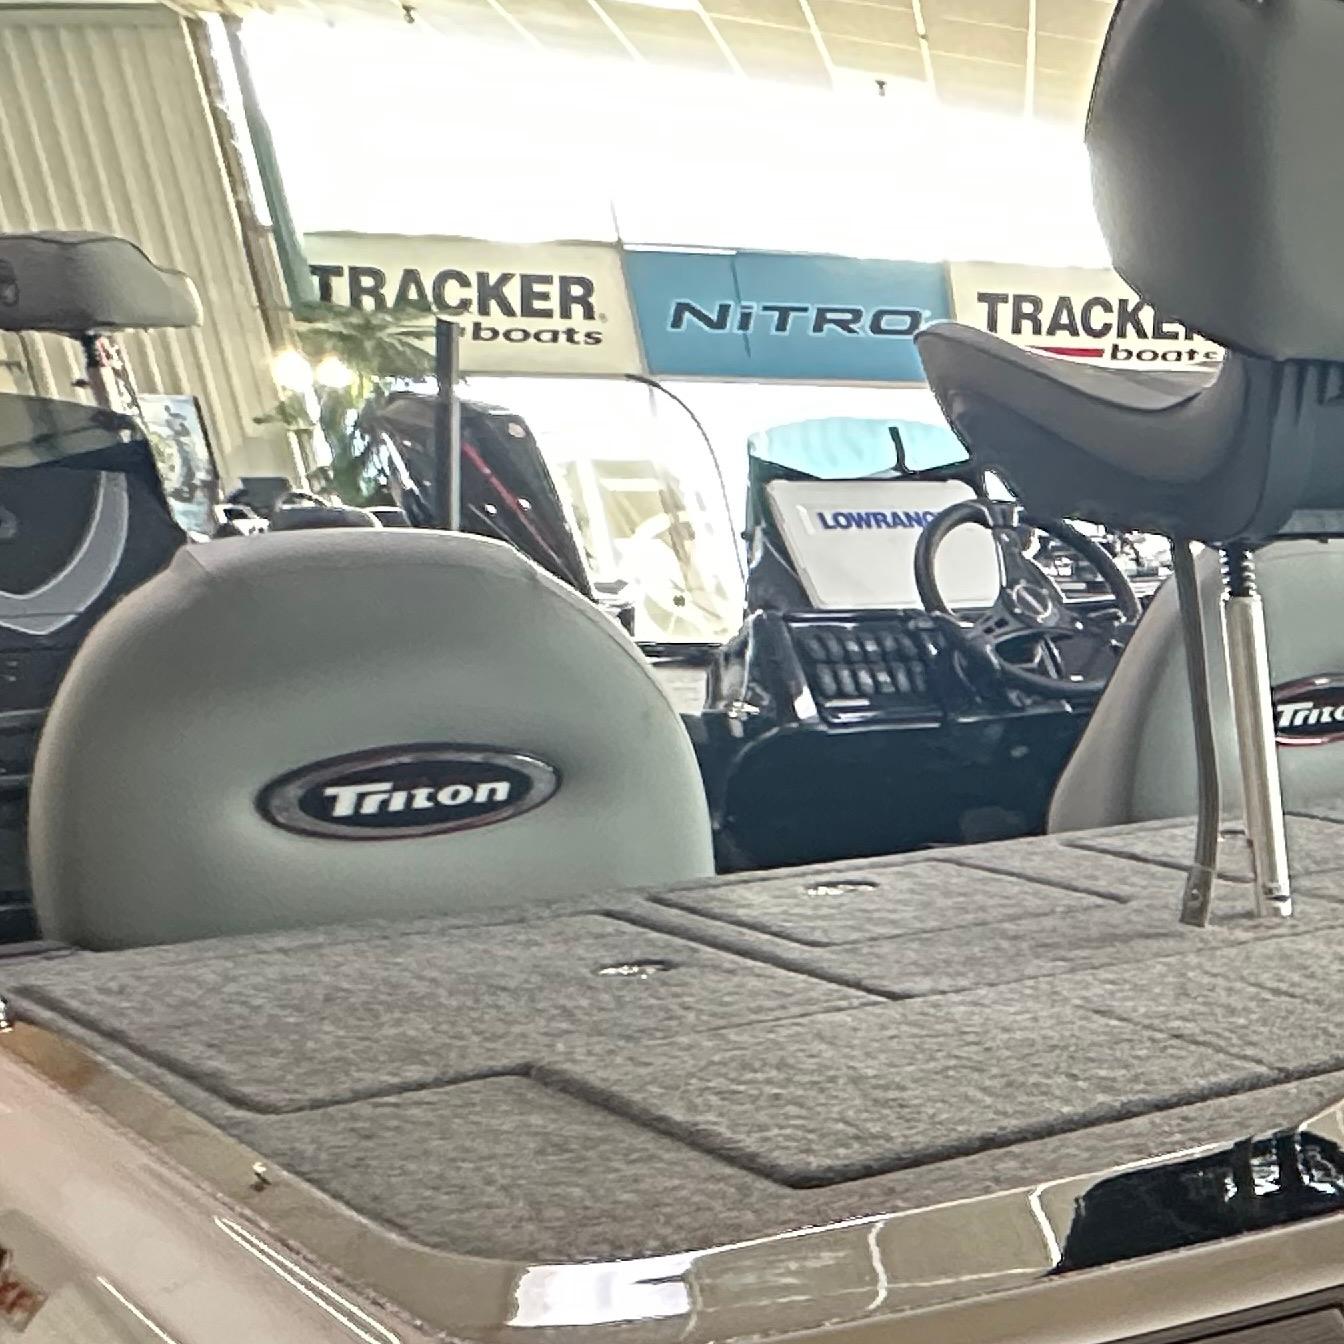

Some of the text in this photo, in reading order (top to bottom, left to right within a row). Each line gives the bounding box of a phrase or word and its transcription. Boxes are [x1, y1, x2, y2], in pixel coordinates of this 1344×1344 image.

[308, 264, 596, 320] TRACKER
[471, 322, 603, 345] boats
[976, 291, 1207, 341] TRACKE
[816, 510, 938, 530] LOWRANC
